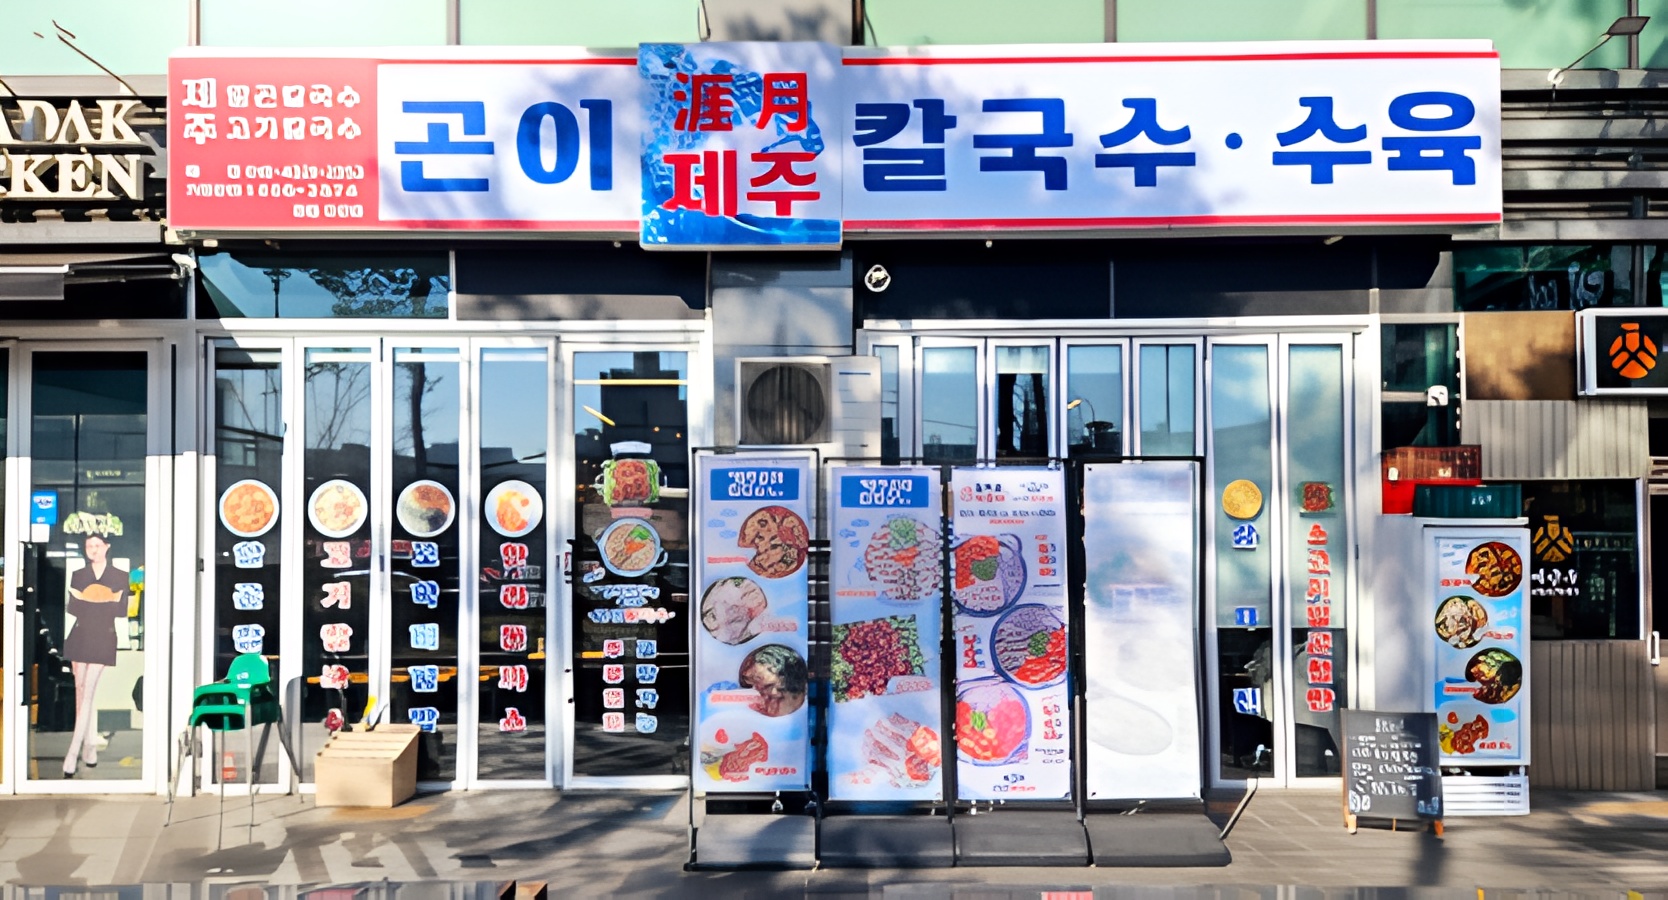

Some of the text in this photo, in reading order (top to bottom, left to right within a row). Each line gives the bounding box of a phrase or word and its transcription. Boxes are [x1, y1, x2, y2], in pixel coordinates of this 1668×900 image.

[673, 72, 808, 132] 涯月
[853, 91, 1482, 192] 칼국수 수육
[394, 99, 612, 192] 곤이
[662, 149, 820, 216] 제주
